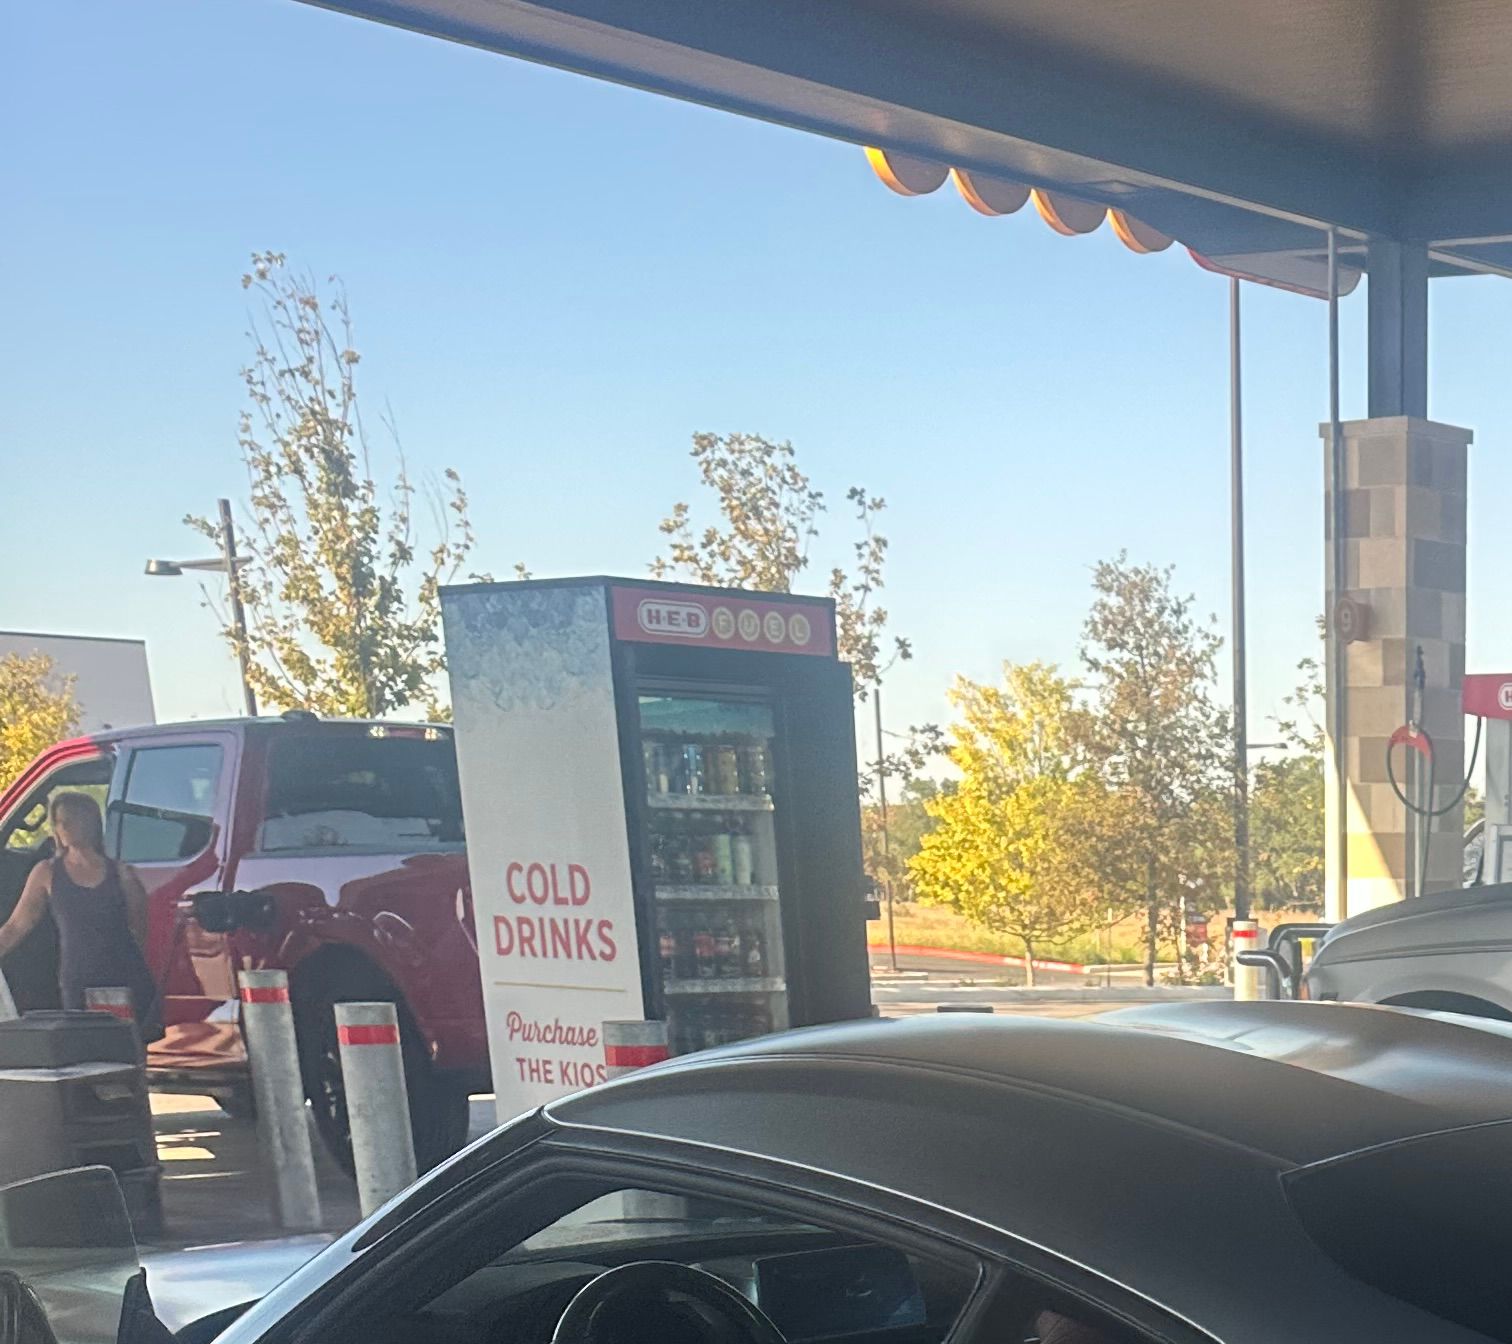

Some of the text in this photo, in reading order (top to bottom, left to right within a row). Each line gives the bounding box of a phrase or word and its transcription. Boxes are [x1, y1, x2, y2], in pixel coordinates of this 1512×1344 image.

[506, 861, 591, 906] COLD
[493, 915, 617, 962] DRINKS
[506, 1011, 599, 1047] Purchase
[516, 1057, 555, 1084] THE
